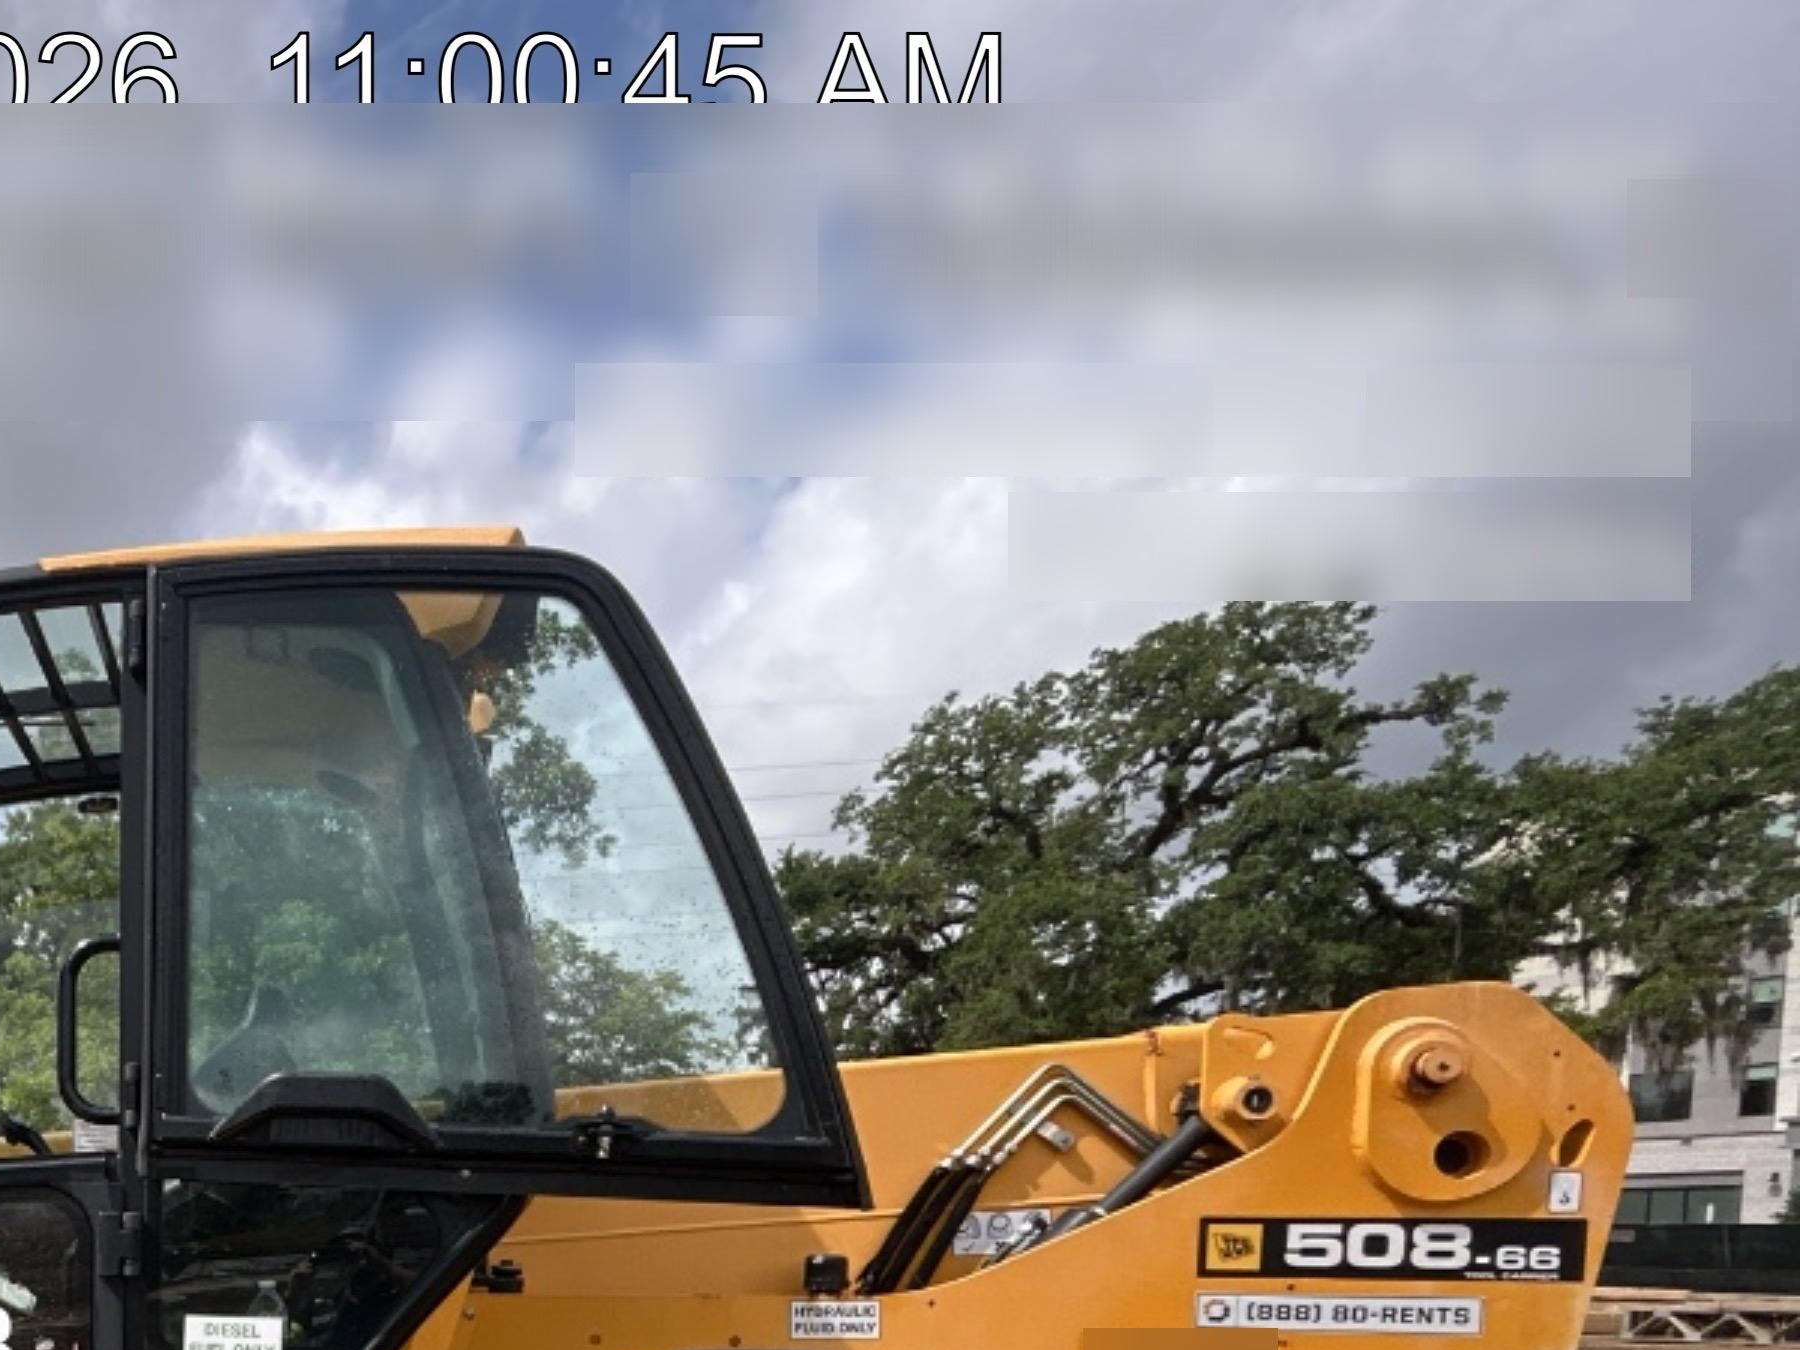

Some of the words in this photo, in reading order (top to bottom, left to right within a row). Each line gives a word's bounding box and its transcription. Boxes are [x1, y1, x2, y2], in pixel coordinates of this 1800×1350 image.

[1283, 1223, 1561, 1270] 508-66
[794, 1304, 877, 1318] HYDRAULIC
[1246, 1302, 1321, 1323] (888)
[1332, 1304, 1471, 1324] 80-RENTS
[204, 1322, 262, 1339] DIESEL
[795, 1321, 834, 1335] FLUID
[840, 1321, 877, 1335] ONLY
